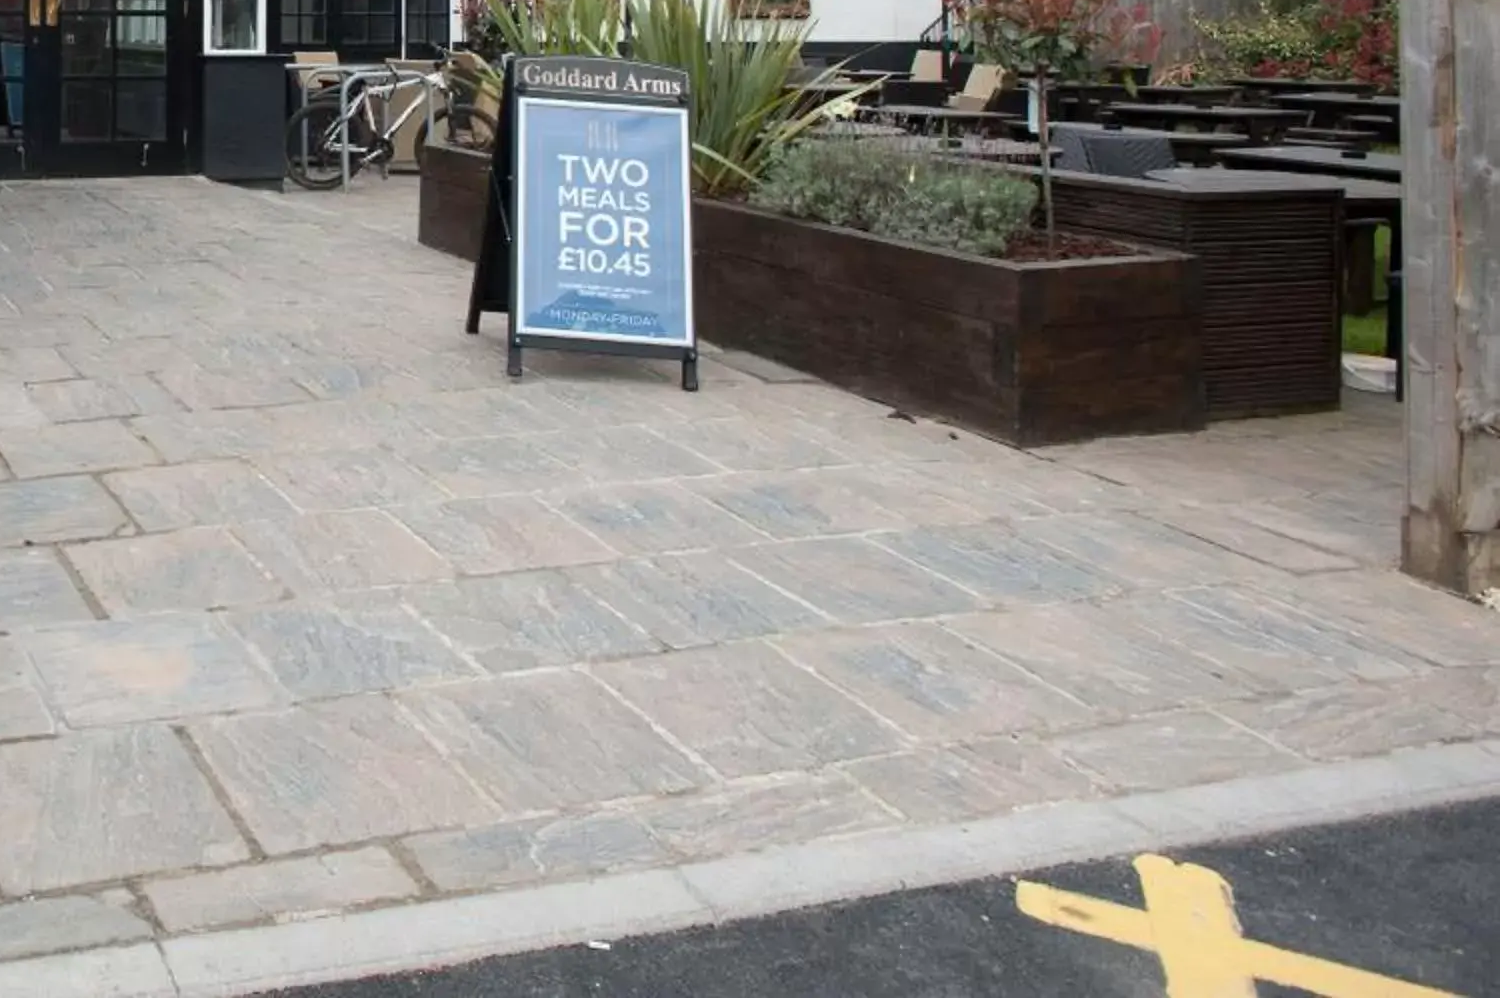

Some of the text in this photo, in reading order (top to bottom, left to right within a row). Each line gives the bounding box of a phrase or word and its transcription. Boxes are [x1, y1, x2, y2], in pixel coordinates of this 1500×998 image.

[522, 63, 682, 96] Goddard Arms
[557, 153, 650, 188] TWO
[557, 185, 652, 212] MEALS
[558, 212, 651, 249] FOR
[557, 248, 652, 277] £10.45
